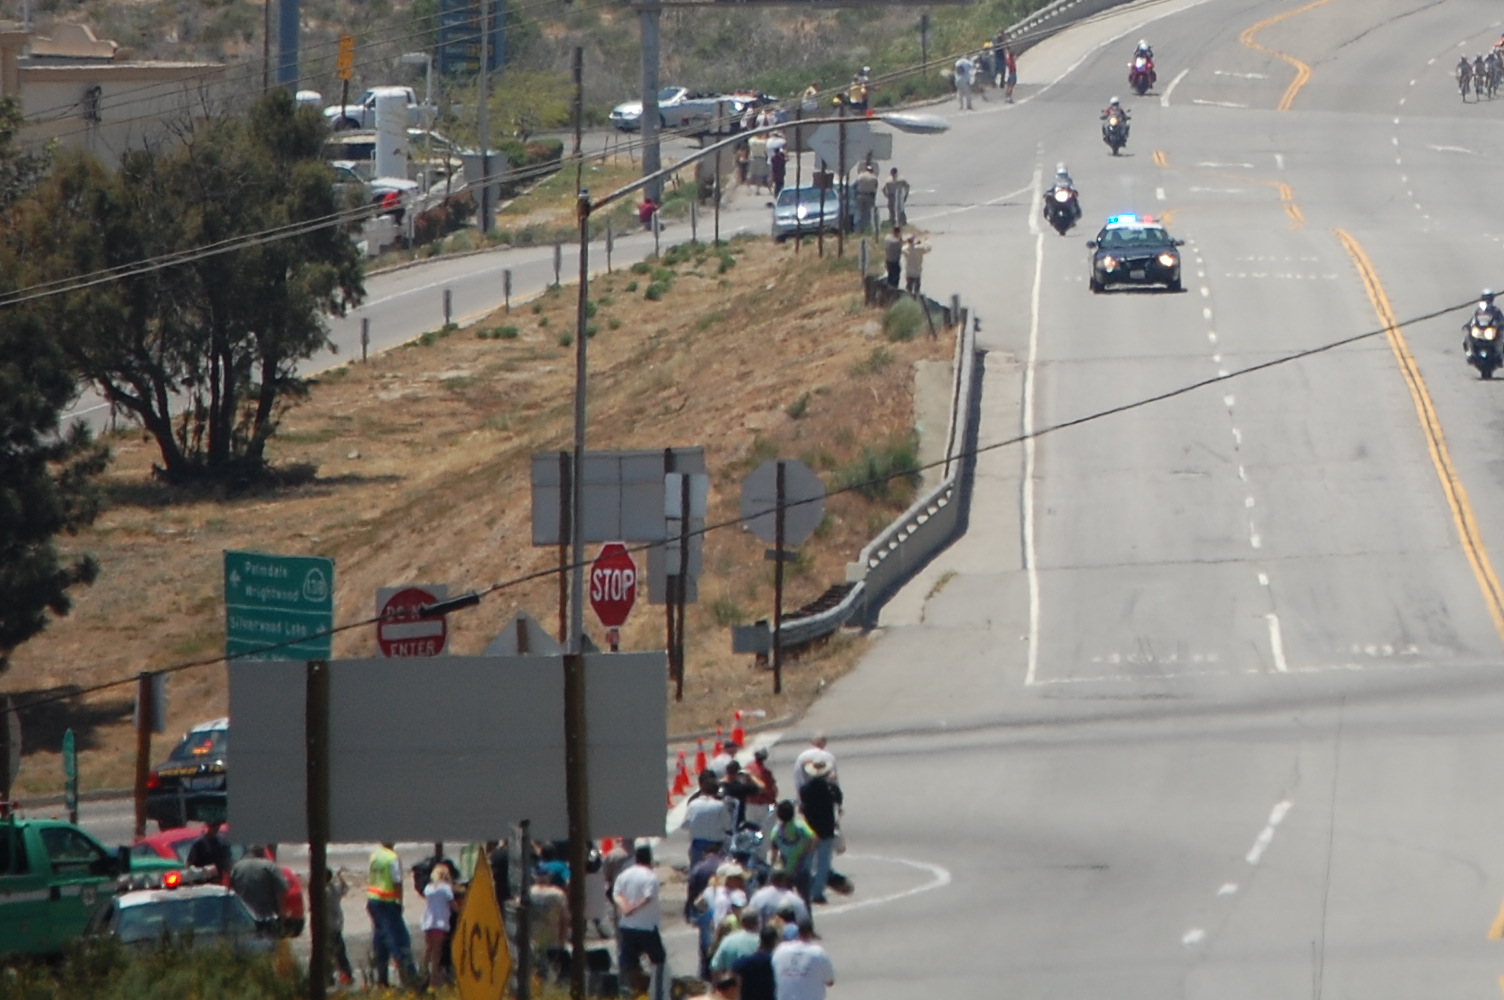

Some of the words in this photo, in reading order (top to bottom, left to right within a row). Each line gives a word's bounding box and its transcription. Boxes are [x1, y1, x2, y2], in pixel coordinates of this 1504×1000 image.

[245, 560, 288, 579] Palmdale
[245, 585, 300, 602] Wrightwood
[592, 567, 635, 602] STOP
[229, 615, 282, 634] Silverwood
[390, 639, 435, 657] ENTER
[460, 919, 500, 985] ICY
